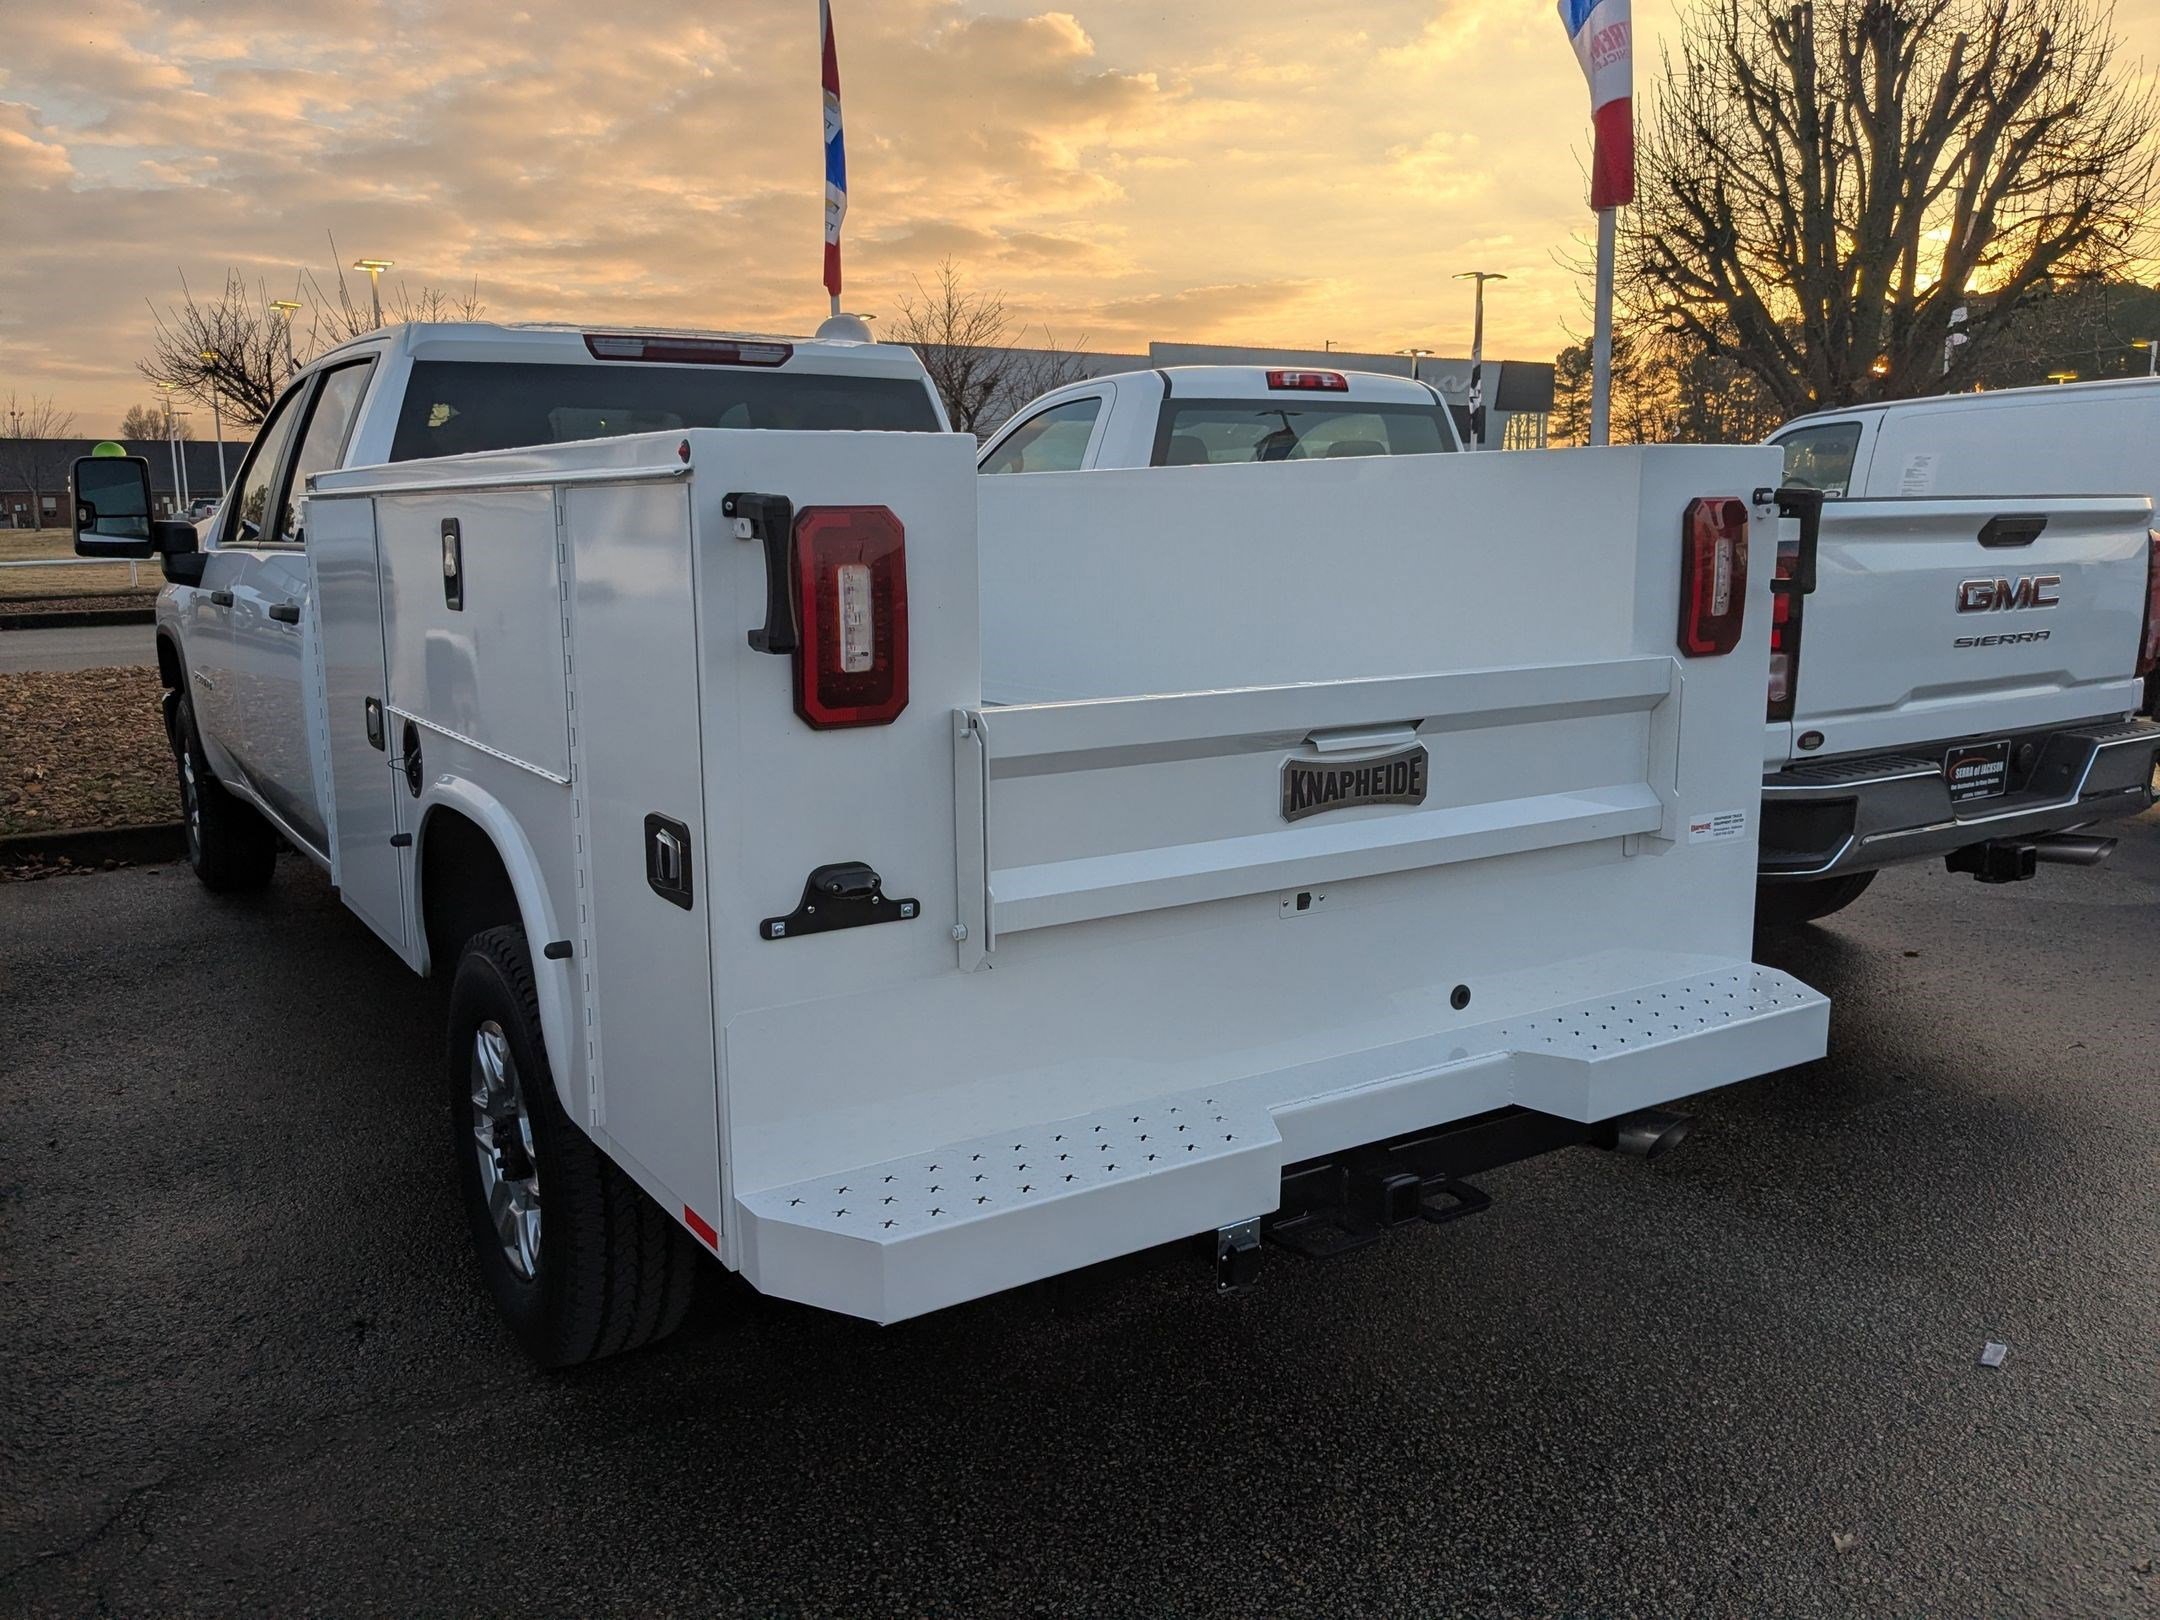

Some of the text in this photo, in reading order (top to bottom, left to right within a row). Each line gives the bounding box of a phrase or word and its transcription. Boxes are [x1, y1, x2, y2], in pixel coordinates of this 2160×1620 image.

[1955, 574, 2062, 617] GMC
[1953, 629, 2051, 649] SIERRA
[1290, 755, 1422, 812] KNAPHEIDE
[1955, 766, 1974, 779] SERRA
[1981, 761, 2004, 775] JACKSON
